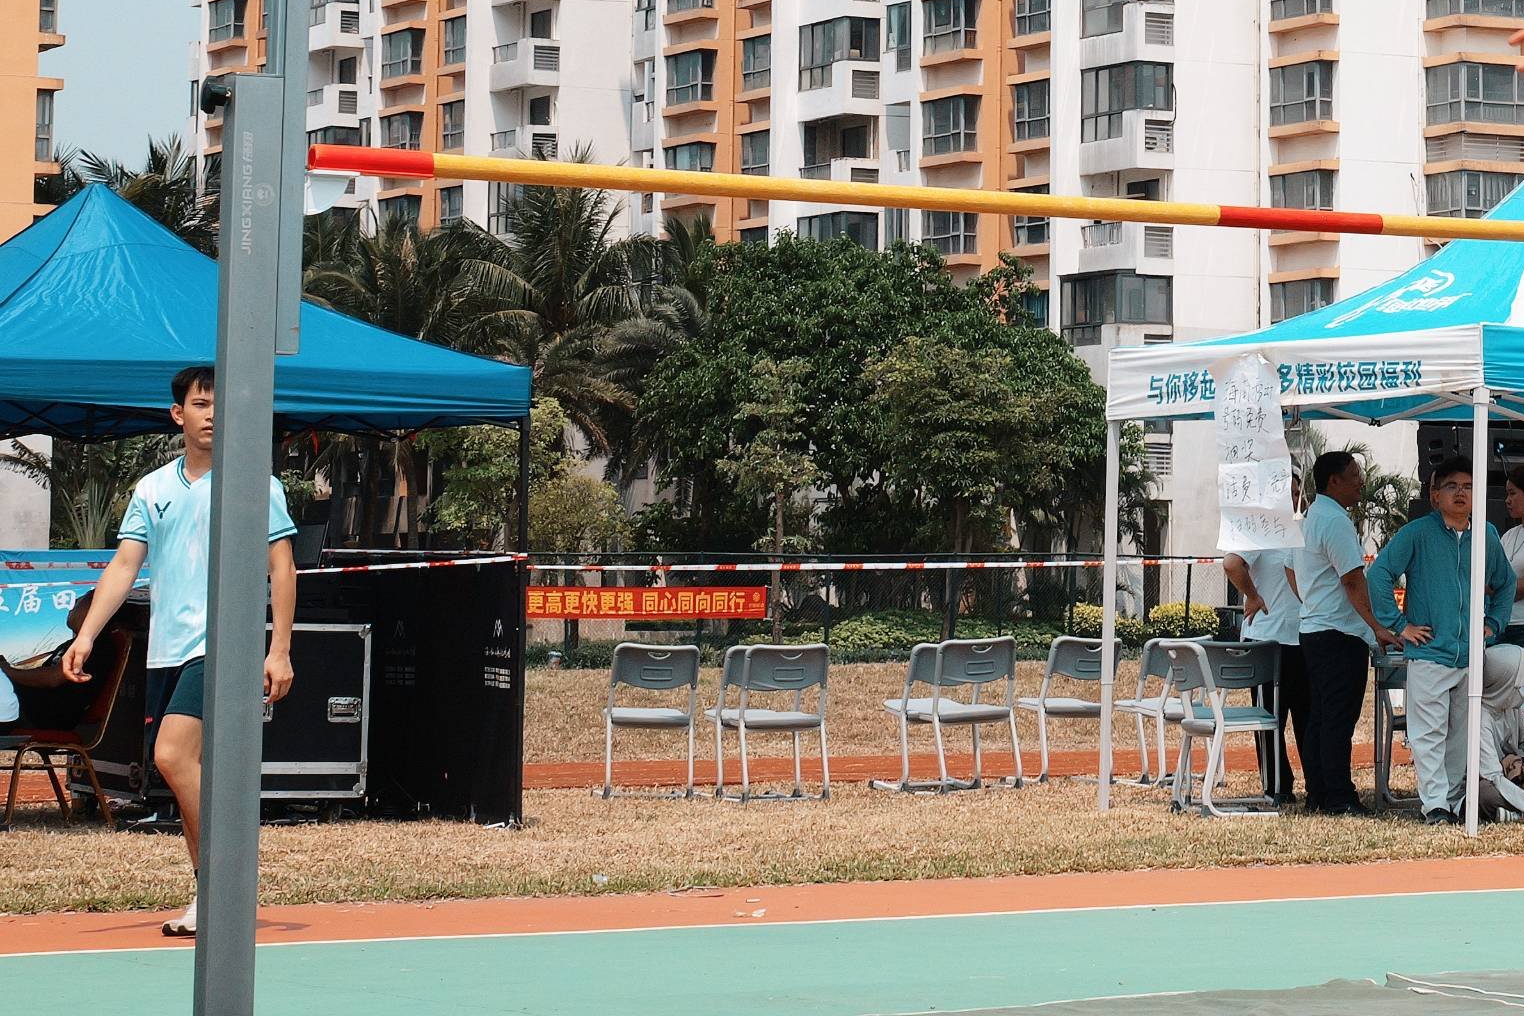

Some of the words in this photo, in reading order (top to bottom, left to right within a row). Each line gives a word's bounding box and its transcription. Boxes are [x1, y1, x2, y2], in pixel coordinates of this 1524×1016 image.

[527, 590, 635, 616] 更高更快更强
[642, 590, 746, 615] 同心同向同行
